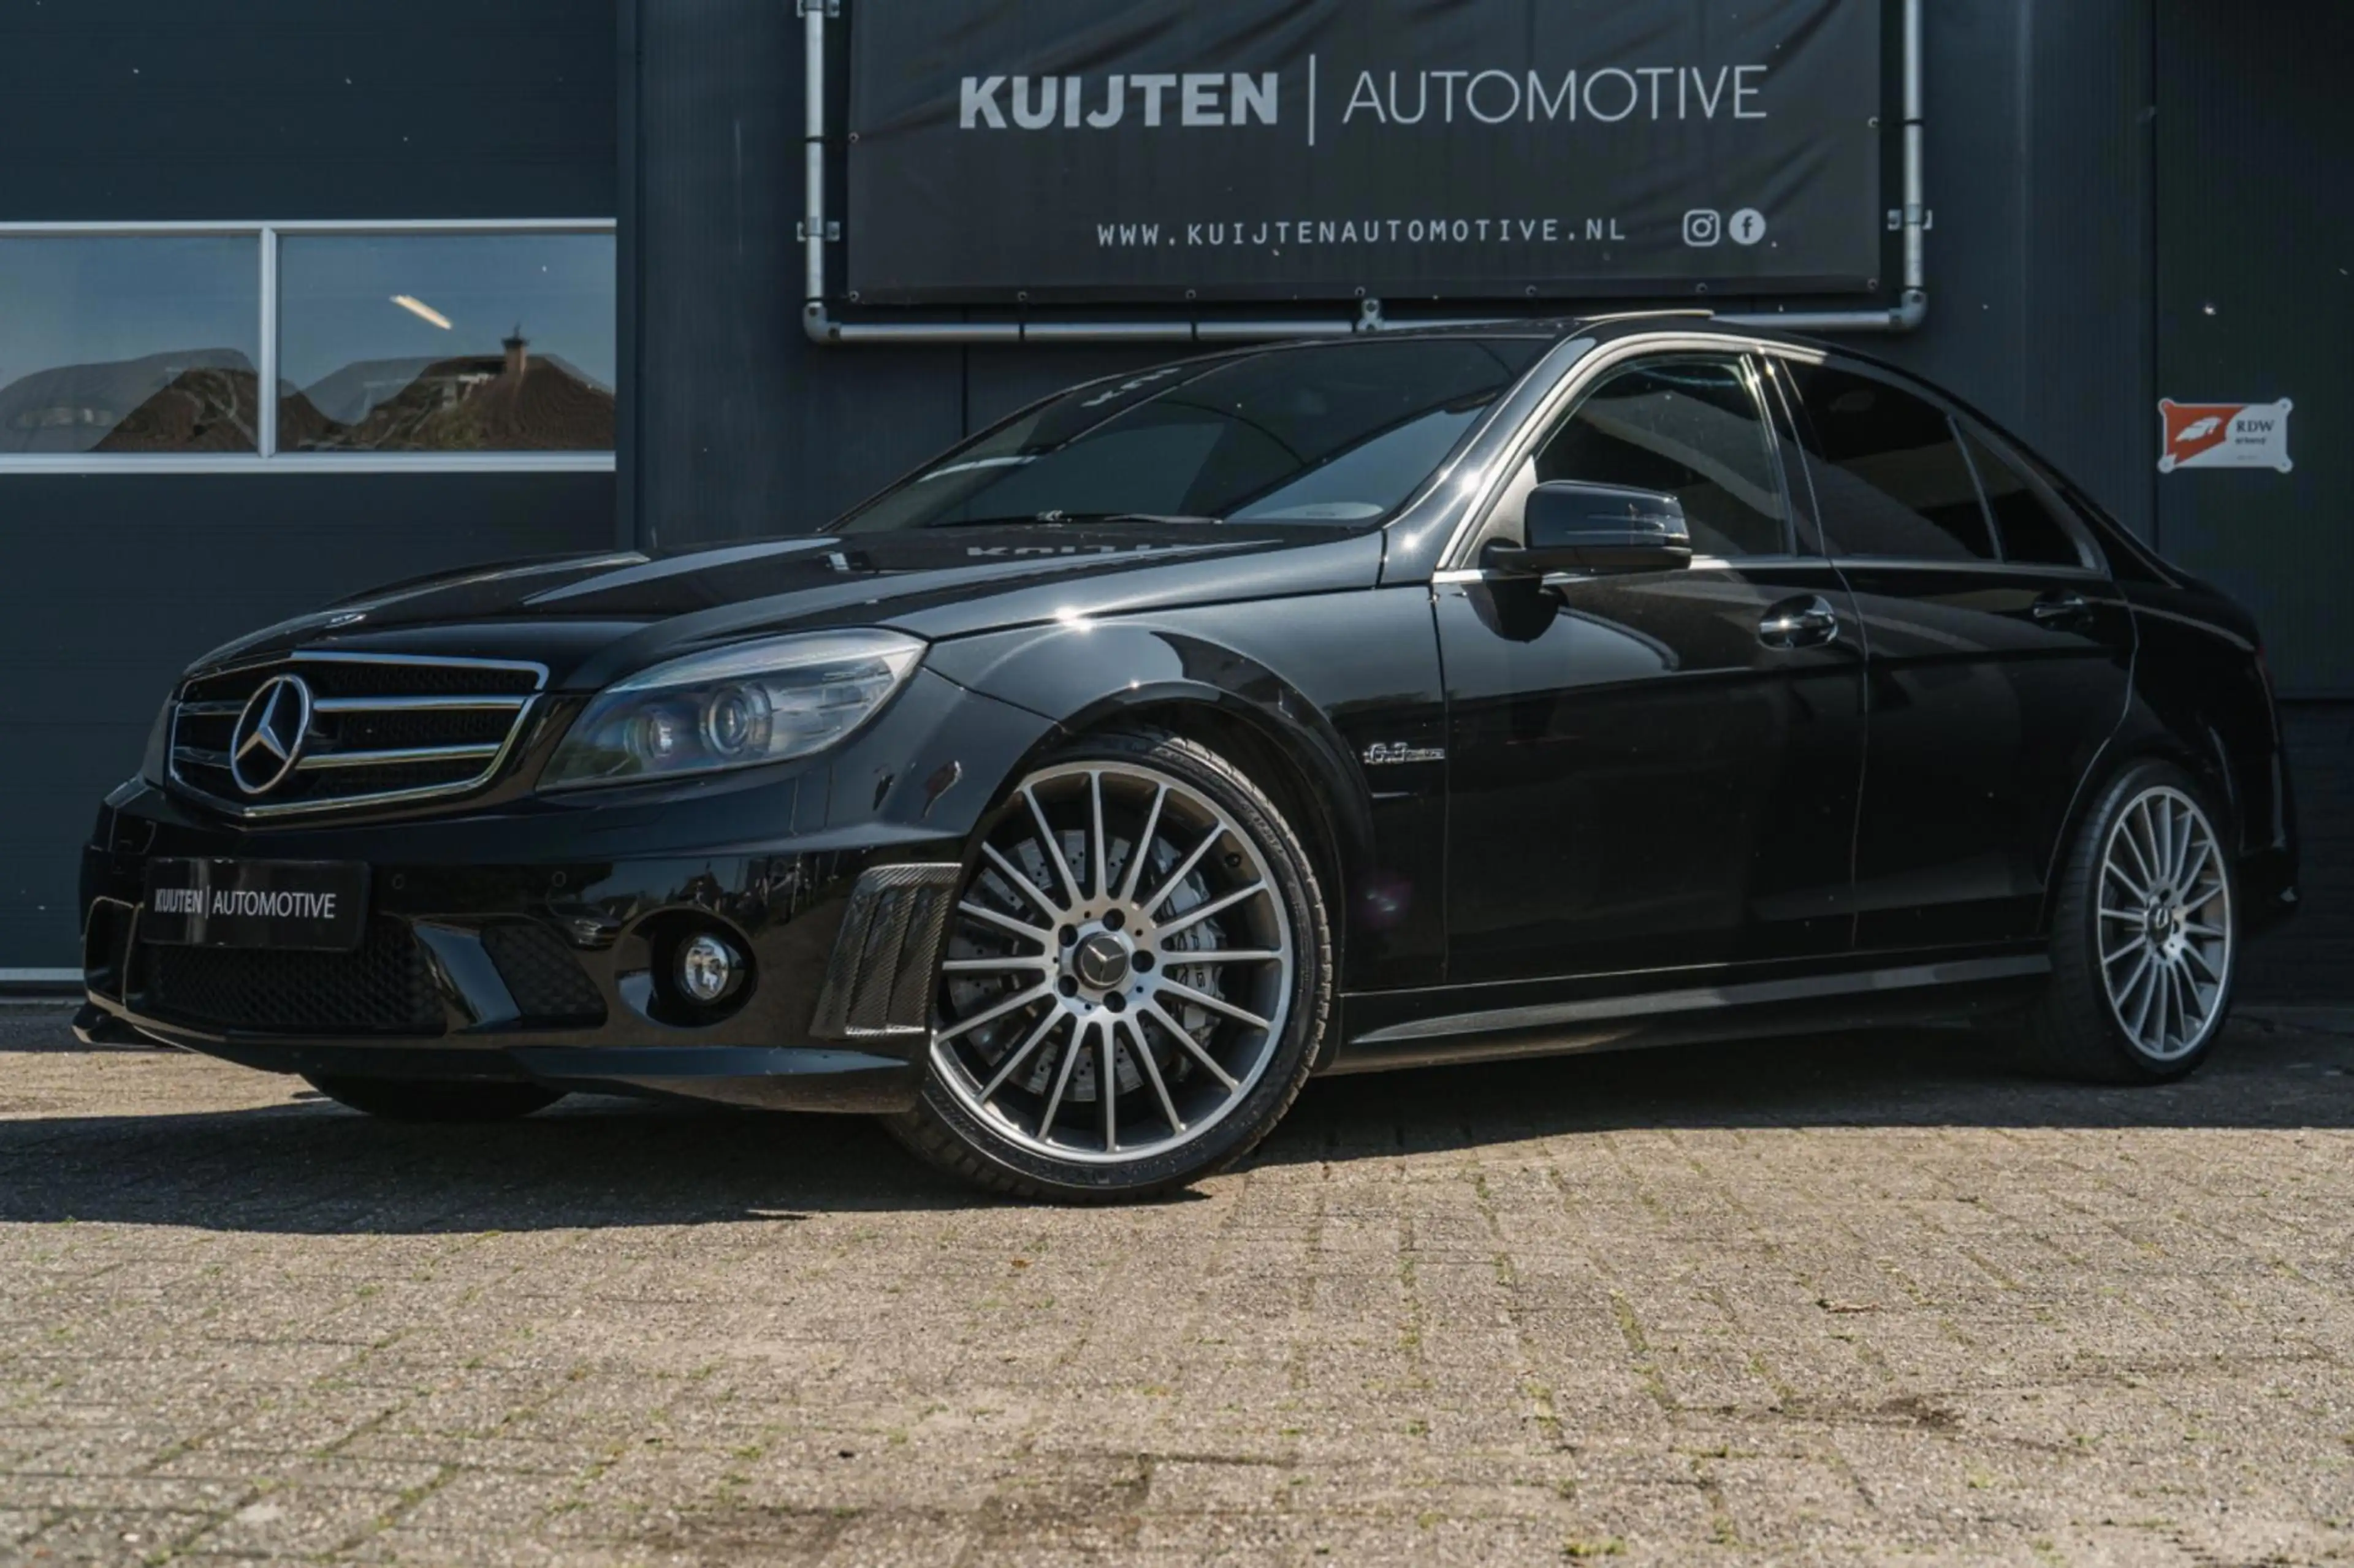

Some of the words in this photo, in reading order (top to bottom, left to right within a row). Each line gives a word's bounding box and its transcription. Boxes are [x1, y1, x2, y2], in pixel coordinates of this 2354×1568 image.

[959, 72, 1279, 129] KUIJTEN
[1343, 66, 1767, 123] AUTOMOTIVE
[1097, 219, 1626, 246] WWW.KUIJTENAUTOMOTIVE.NL
[2236, 420, 2275, 433] RDW
[212, 891, 337, 918] AUTOMOTIVE
